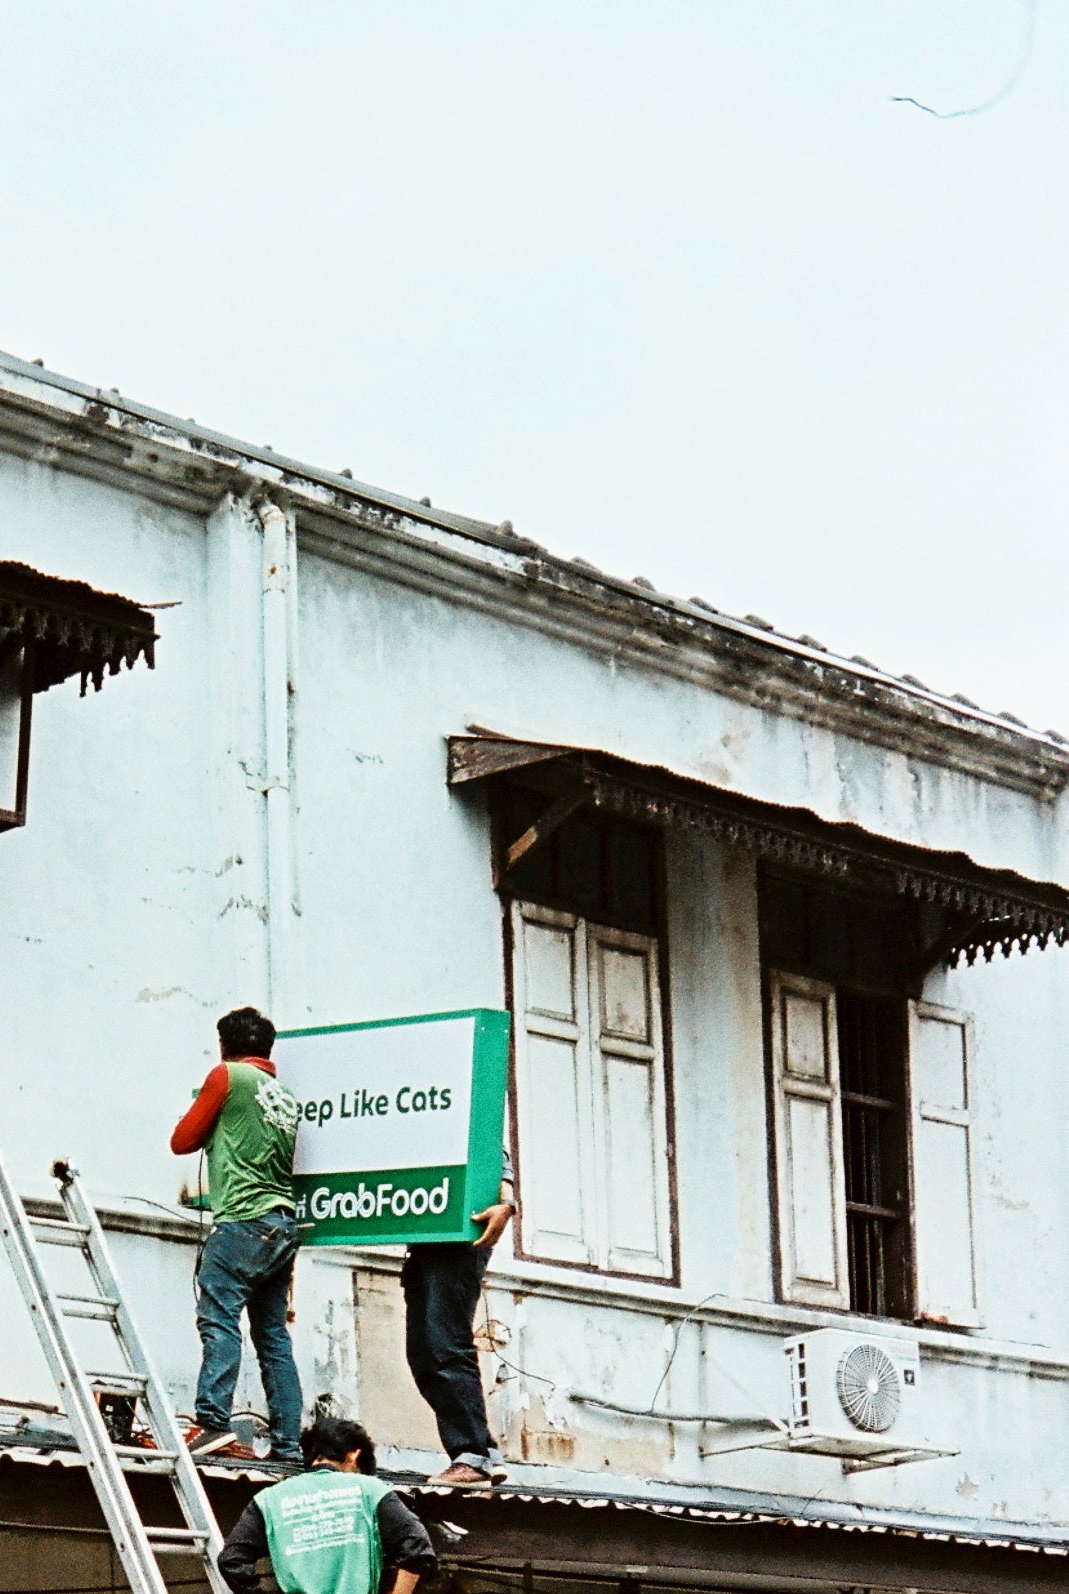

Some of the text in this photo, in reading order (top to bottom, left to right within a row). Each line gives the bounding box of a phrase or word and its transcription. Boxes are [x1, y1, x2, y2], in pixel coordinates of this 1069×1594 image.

[340, 1089, 389, 1118] Like
[396, 1086, 452, 1113] Cats
[310, 1177, 450, 1220] GrabFood
